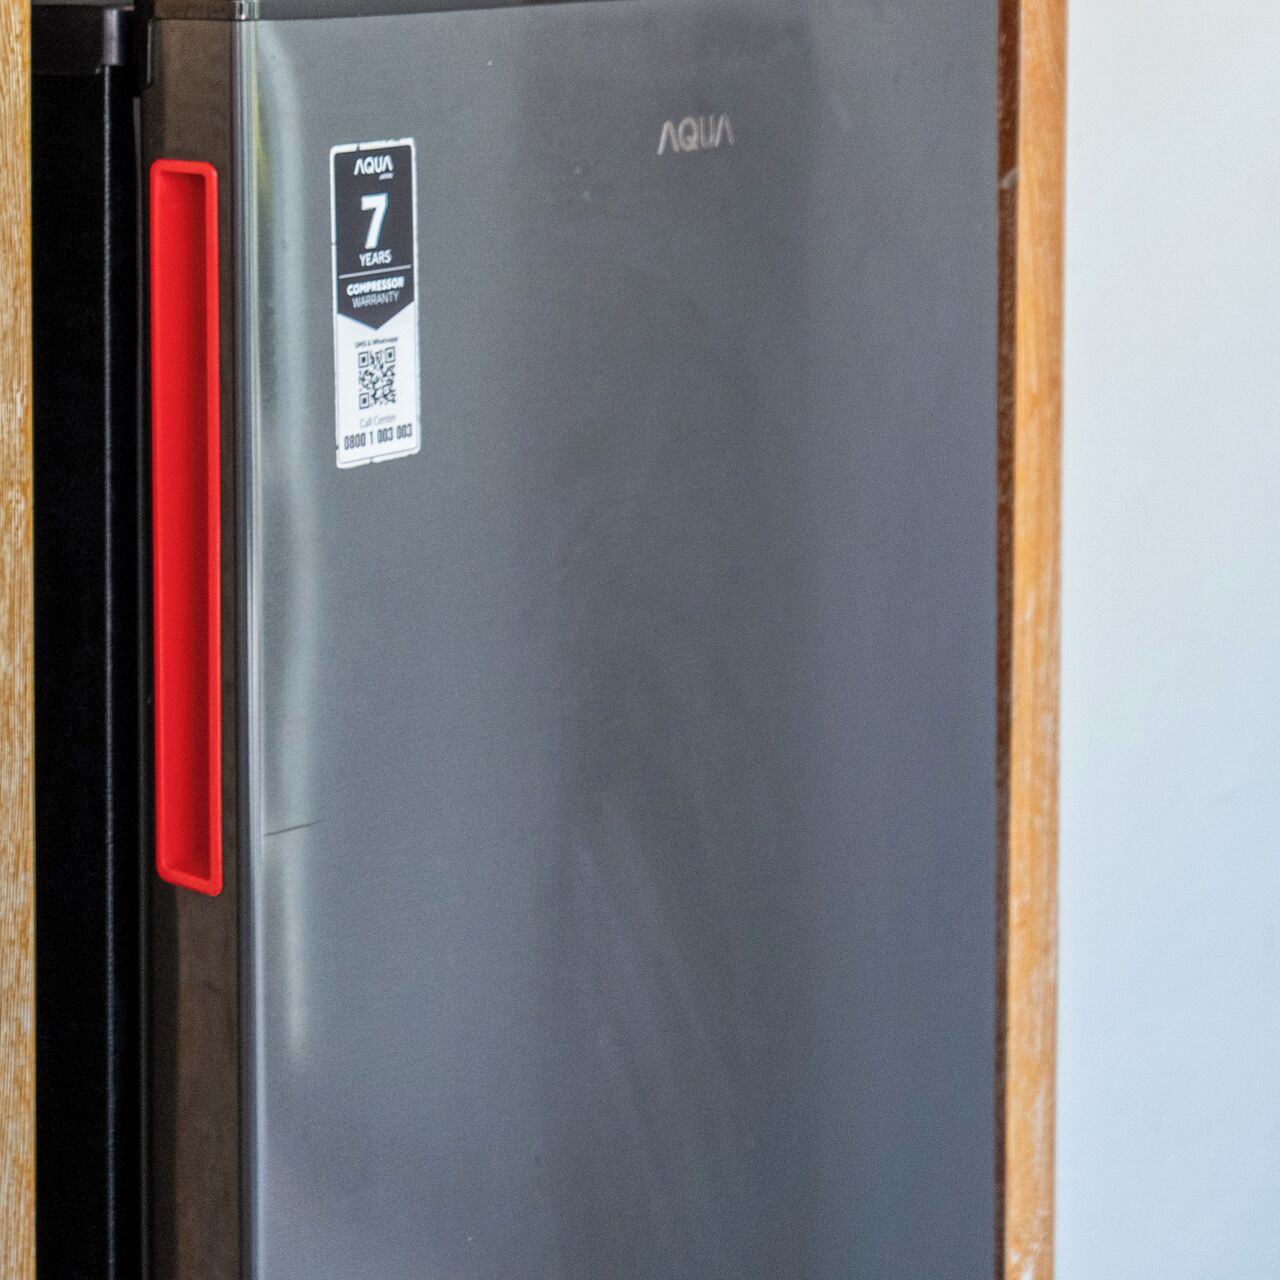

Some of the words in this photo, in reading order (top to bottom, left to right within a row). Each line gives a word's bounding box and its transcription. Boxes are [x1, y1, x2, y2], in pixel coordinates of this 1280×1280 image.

[656, 113, 735, 156] AQUA
[353, 154, 394, 176] AQUA
[360, 192, 389, 250] 7
[359, 249, 393, 267] YEARS
[346, 276, 405, 296] COMPRESSOR
[352, 290, 400, 309] WARRANTY
[344, 432, 366, 450] 0800
[369, 431, 374, 445] 1
